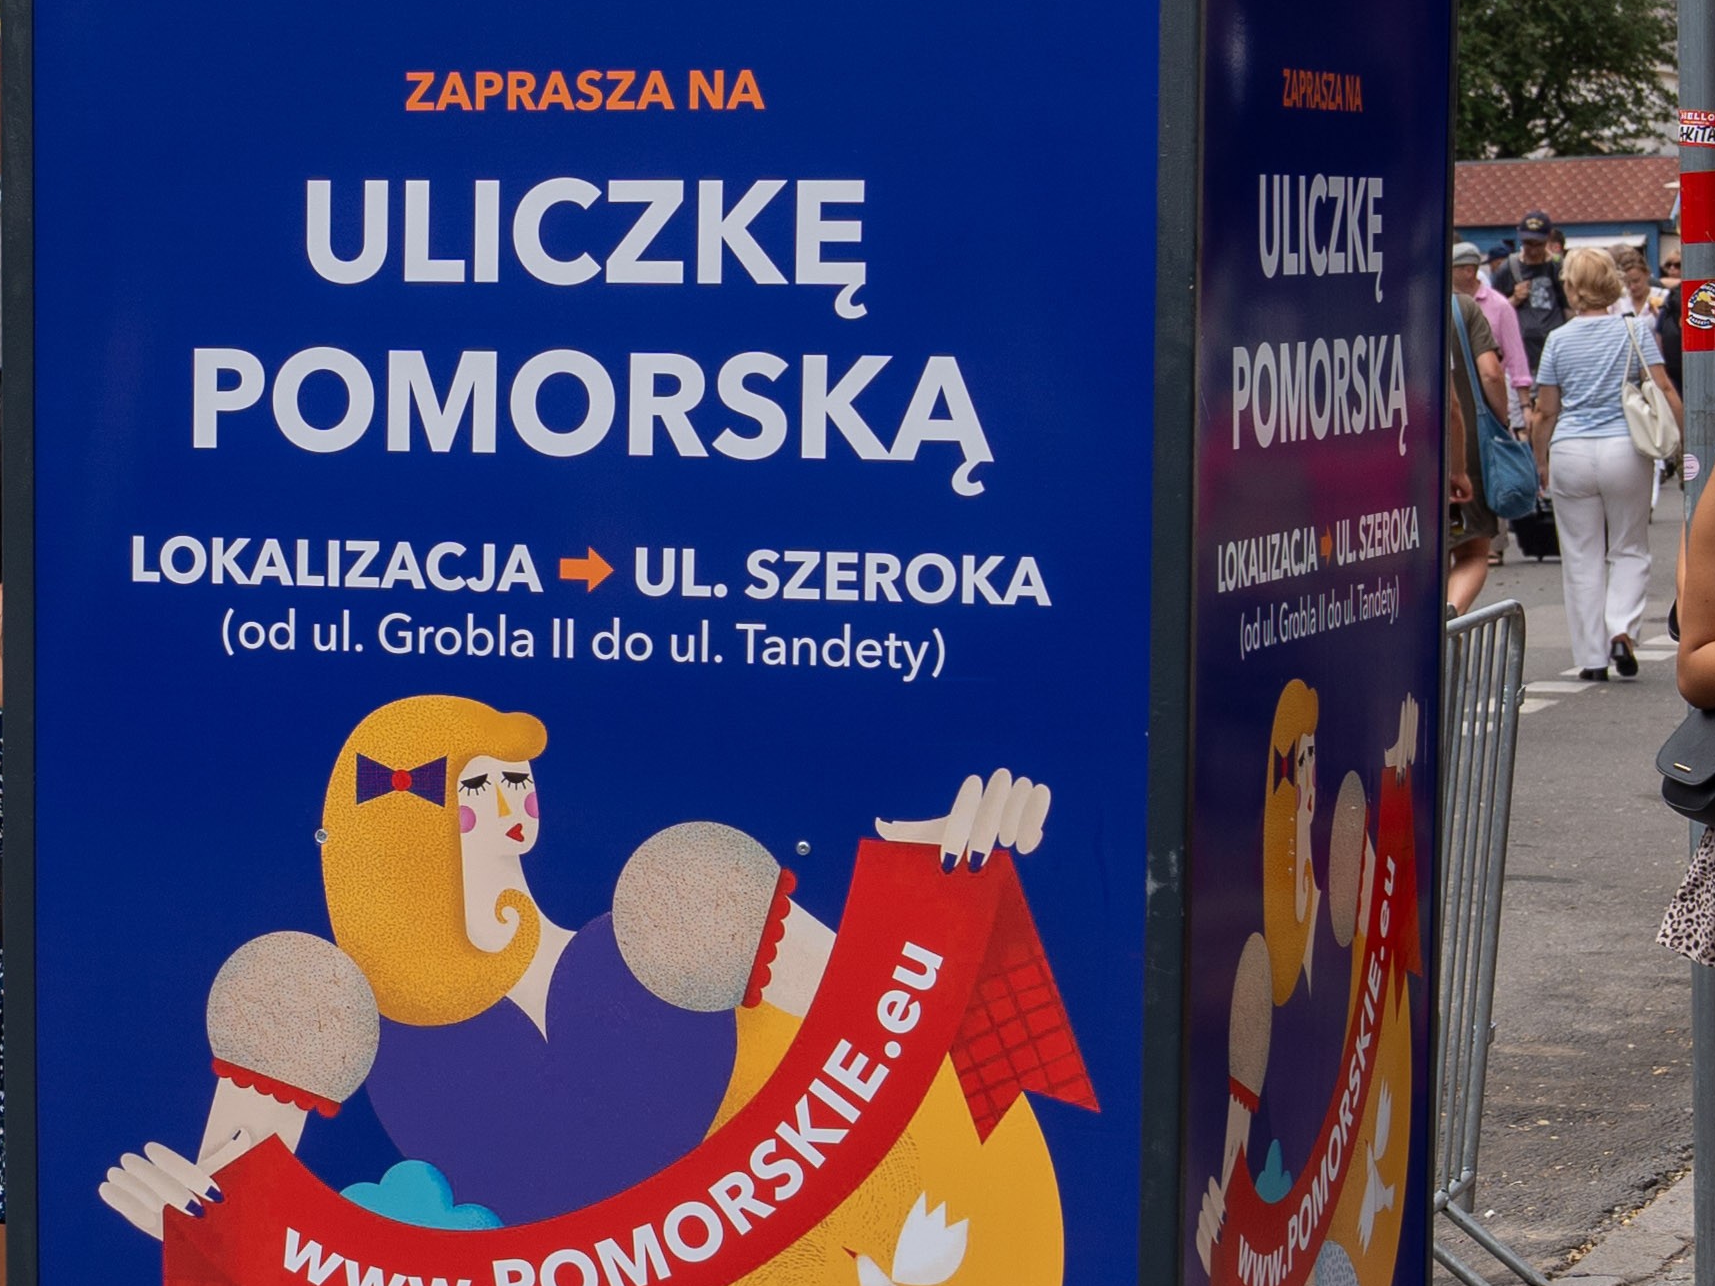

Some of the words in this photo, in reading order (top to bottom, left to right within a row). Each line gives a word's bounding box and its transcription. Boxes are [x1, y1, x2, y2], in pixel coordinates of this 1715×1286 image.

[405, 69, 675, 113] ZAPRASZA
[687, 69, 766, 112] NA
[1282, 68, 1344, 111] ZAPRASZA
[1345, 73, 1364, 113] NA
[305, 176, 870, 320] ULICZKĘ
[1259, 173, 1383, 303] ULICZKĘ
[191, 346, 997, 498] POMORSKĄ
[1232, 333, 1409, 457] POMORSKĄ
[131, 535, 544, 594] LOKALIZACJA
[634, 546, 728, 599] UL.
[744, 548, 1053, 607] SZEROKA
[1218, 526, 1318, 593] LOKALIZACJA
[1336, 519, 1356, 566] UL.
[1358, 506, 1420, 561] SZEROKA
[219, 607, 296, 657] (od
[313, 609, 364, 652] ul.
[377, 611, 535, 659] Grobla
[551, 617, 575, 660] II
[590, 617, 654, 662] do
[669, 619, 723, 664] ul.
[735, 622, 947, 684] Tandety)
[1240, 606, 1261, 661] (od
[1262, 604, 1277, 647] ul.
[1278, 595, 1317, 643] Grobla
[1327, 588, 1342, 630] do
[1343, 584, 1356, 625] ul.
[1357, 575, 1400, 624] Tandety)
